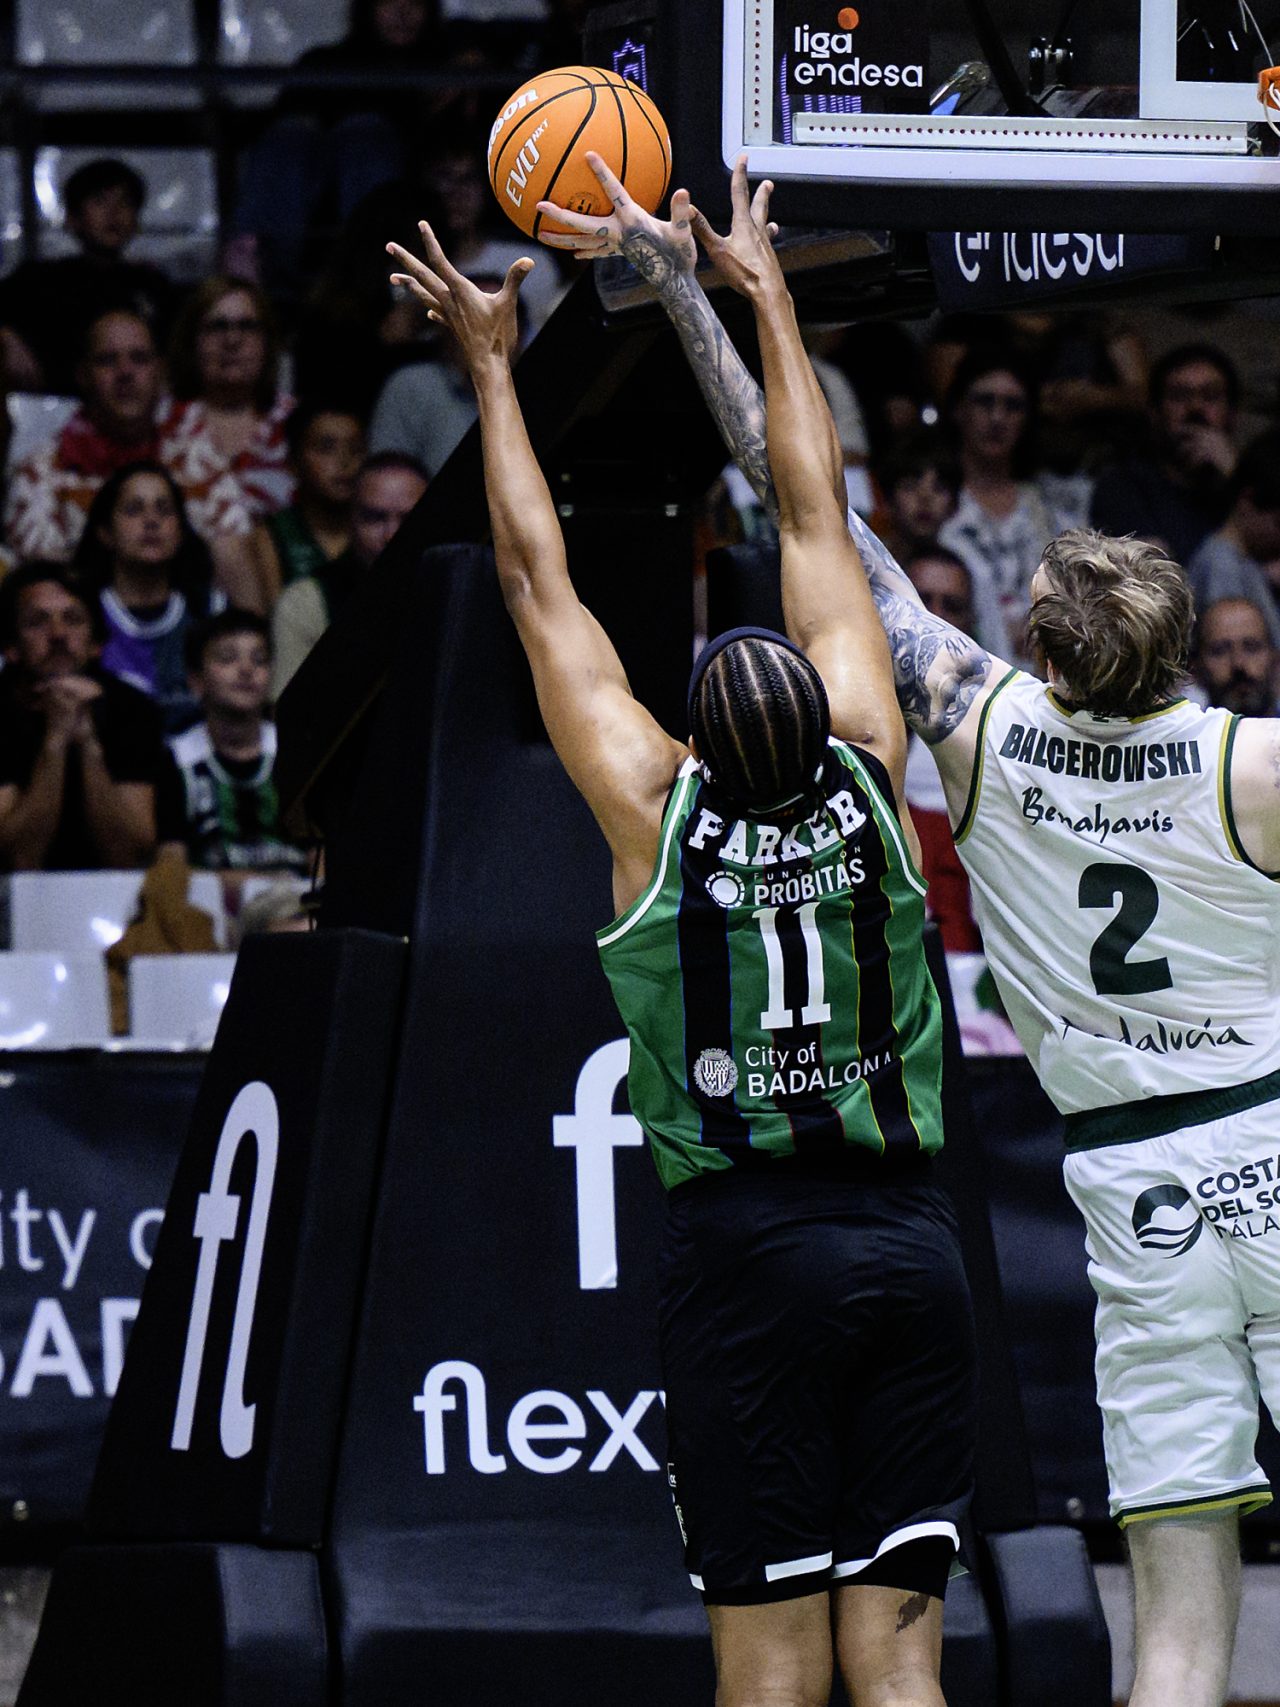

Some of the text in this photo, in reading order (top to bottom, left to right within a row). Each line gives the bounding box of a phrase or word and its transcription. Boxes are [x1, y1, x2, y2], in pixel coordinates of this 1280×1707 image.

[794, 24, 852, 58] liga
[794, 57, 923, 87] endesa
[998, 723, 1202, 783] BALCEROWSKI
[688, 790, 867, 866] PARKER
[754, 858, 866, 906] PROBITAS
[1078, 862, 1174, 996] 2
[751, 901, 832, 1030] 11
[745, 1042, 817, 1070] City of
[1201, 1197, 1254, 1224] DEL
[413, 1360, 667, 1475] flex
